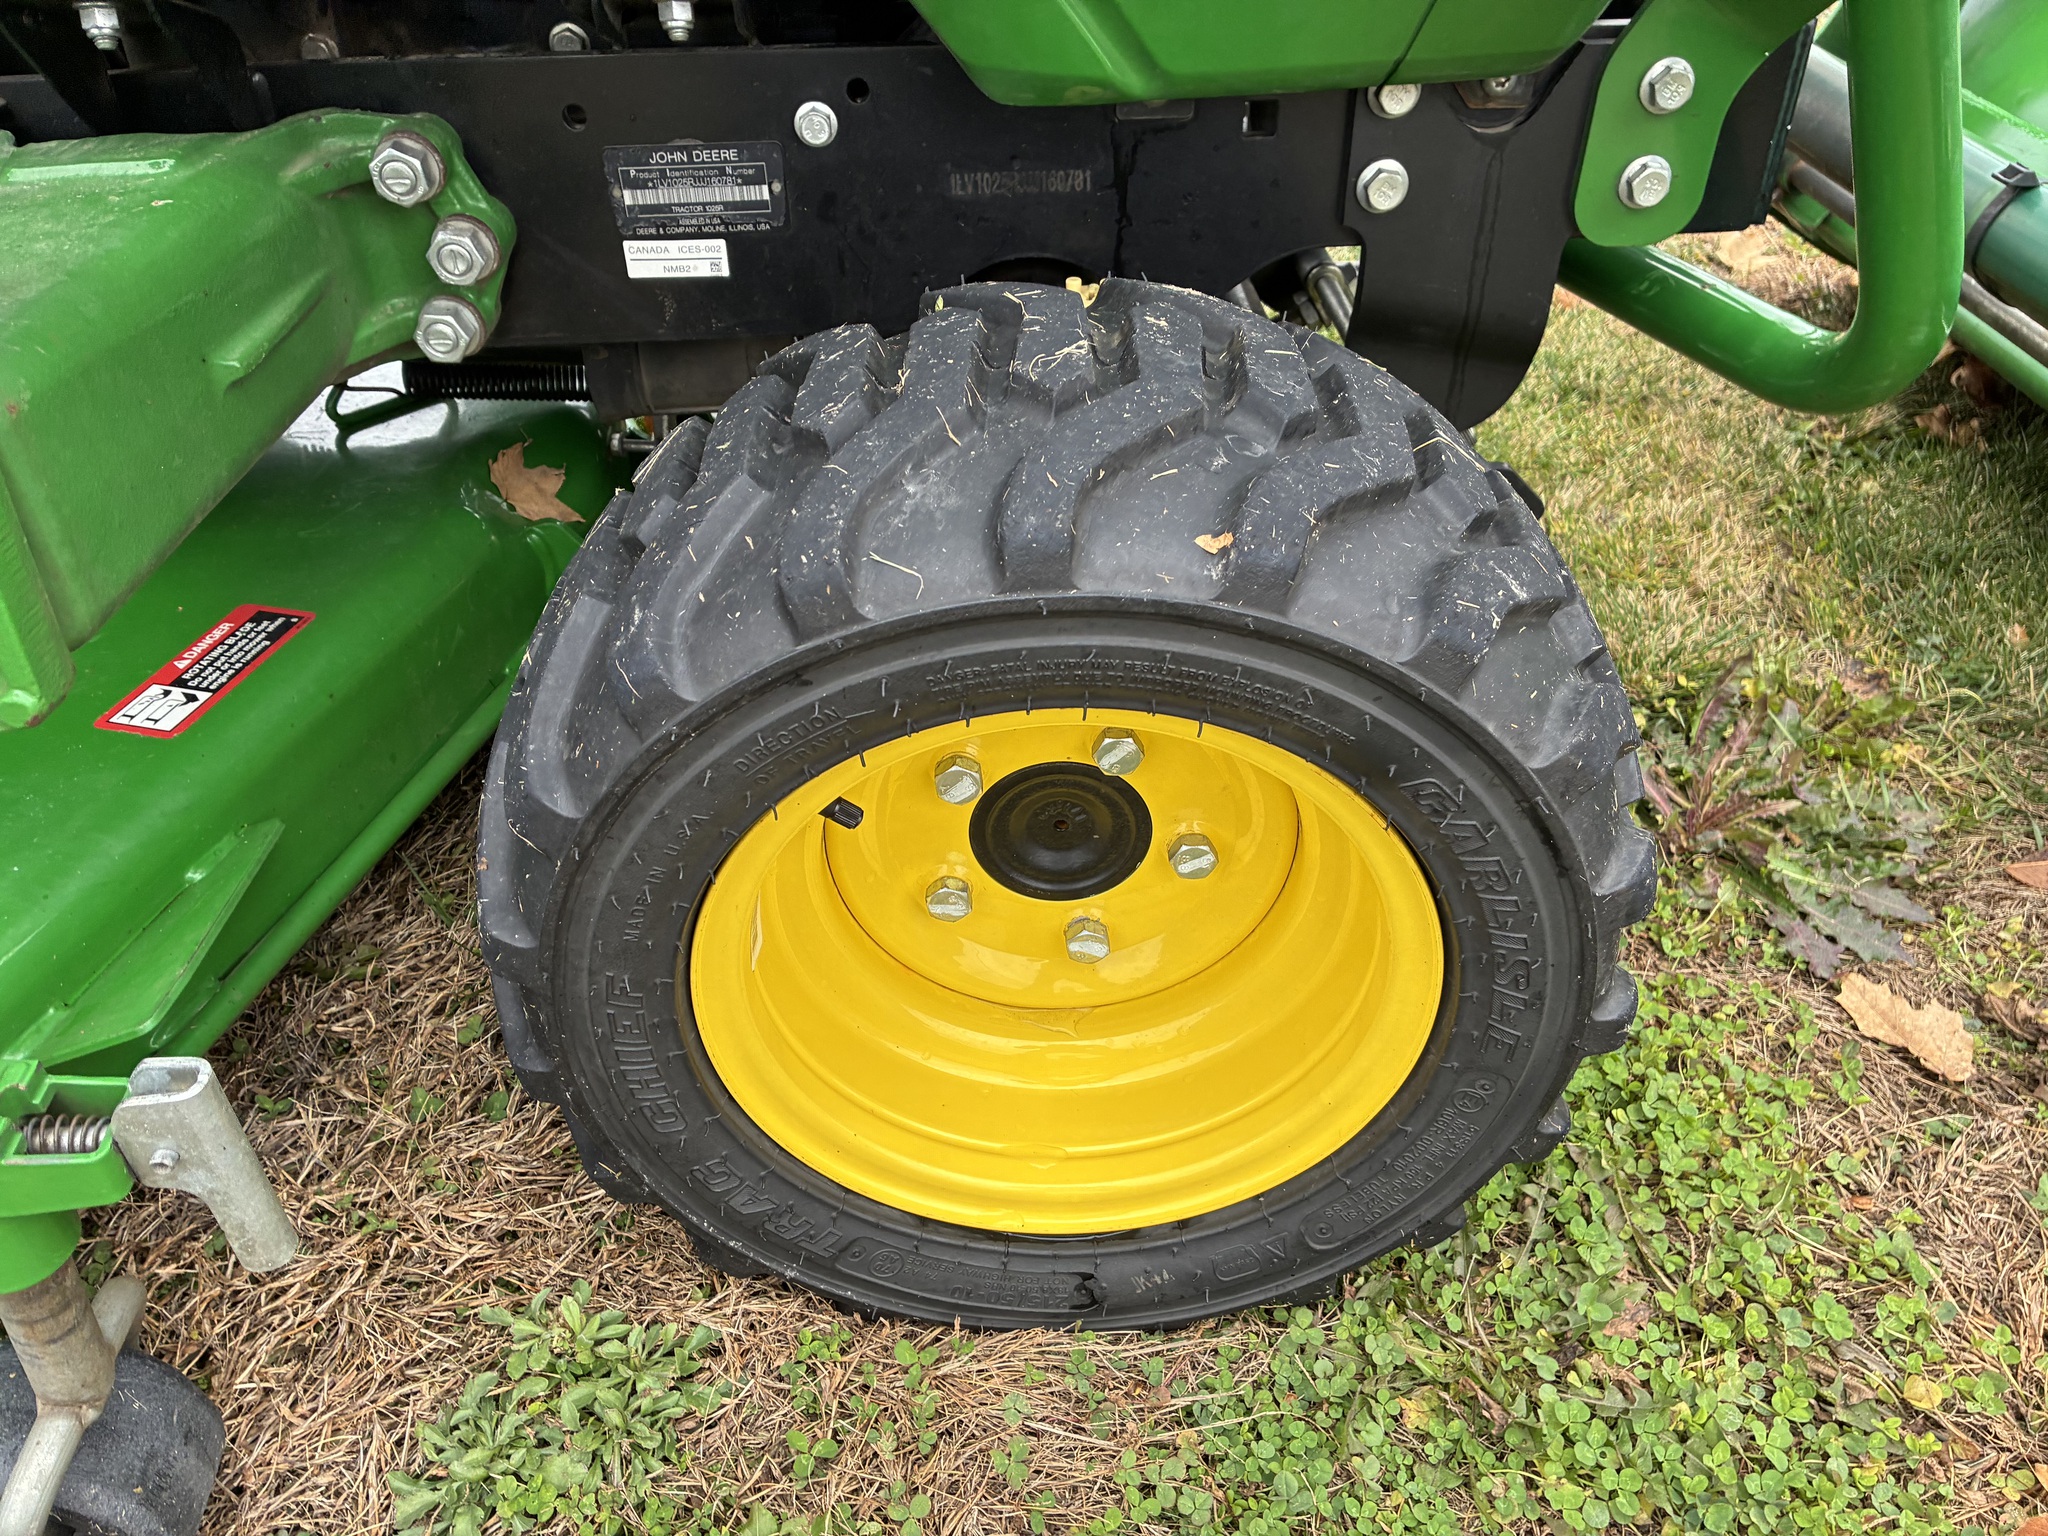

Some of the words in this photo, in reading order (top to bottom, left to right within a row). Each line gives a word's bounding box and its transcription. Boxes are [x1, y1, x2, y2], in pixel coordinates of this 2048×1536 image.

[649, 151, 688, 164] JOHN
[692, 149, 739, 162] DEERE
[629, 170, 660, 179] Product
[666, 168, 719, 177] Identification
[725, 166, 756, 175] Number
[671, 205, 704, 213] TRACTOR
[636, 227, 657, 235] DEERE
[659, 227, 664, 235] &
[756, 222, 771, 231] USA
[628, 246, 670, 255] CANADA
[678, 245, 722, 254] ICES-002
[182, 622, 235, 659] DANGER
[181, 644, 229, 680] ROTATING
[1036, 658, 1086, 671] INJURY
[1090, 658, 1120, 670] MAY
[1123, 659, 1177, 675] RESULT
[187, 676, 203, 687] Do
[733, 706, 844, 773] DIRECTION
[753, 765, 779, 785] OF
[782, 725, 862, 764] TRAVEL
[622, 893, 651, 942] MADE
[645, 865, 668, 884] IN
[1398, 777, 1530, 1064] CARLISLE
[605, 971, 688, 1134] CHIEF
[1324, 1176, 1389, 1219] TUBELESS
[689, 1157, 843, 1259] TRAC
[1363, 1193, 1407, 1224] NYLON
[907, 1255, 955, 1273] SERVICE
[959, 1266, 1012, 1282] HIGHWAY
[1016, 1275, 1040, 1284] FOR
[1044, 1275, 1070, 1286] NOT
